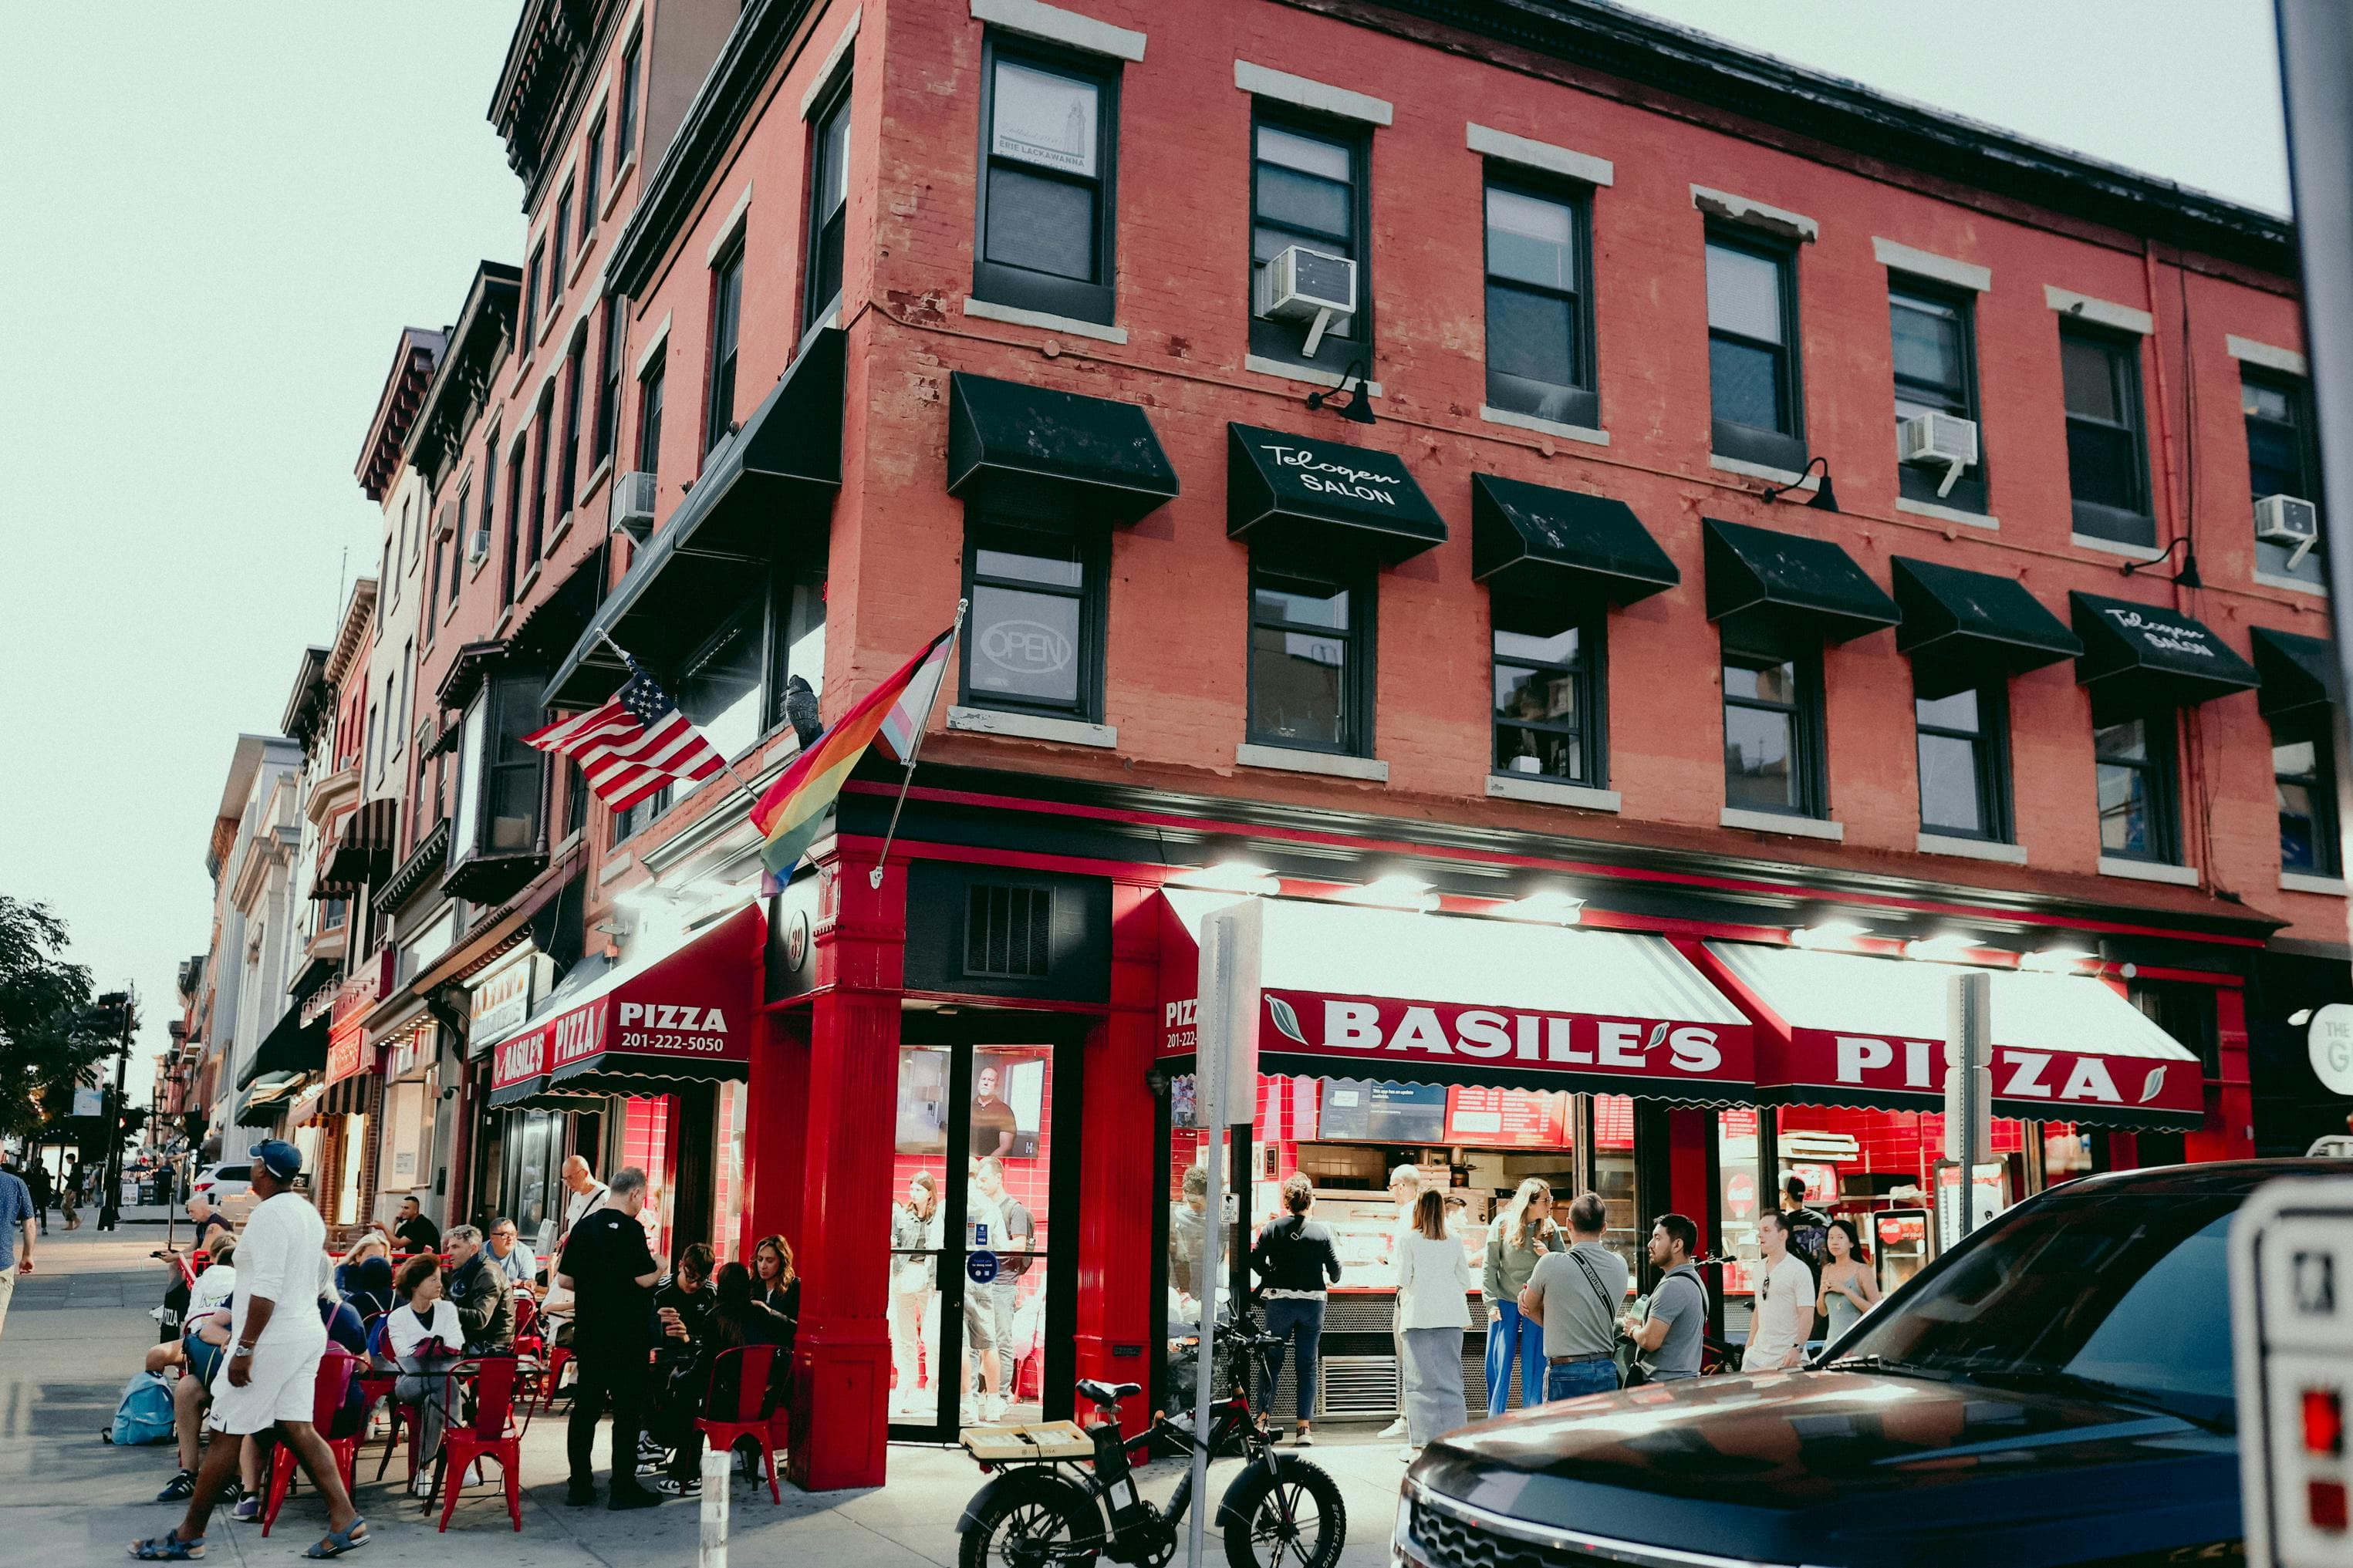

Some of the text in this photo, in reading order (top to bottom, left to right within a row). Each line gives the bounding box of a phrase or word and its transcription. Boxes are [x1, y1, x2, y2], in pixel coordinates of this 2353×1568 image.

[1000, 140, 1019, 152] ERIE
[1021, 145, 1085, 167] LACKAWANNA
[1261, 445, 1401, 484] Telogen
[1300, 474, 1396, 506] SALON
[984, 629, 1063, 668] OPEN
[619, 1002, 729, 1033] PIZZA
[1166, 998, 1198, 1028] PIZZ
[504, 1032, 545, 1081] BASILE'S
[554, 1007, 595, 1064] PIZZA
[621, 1033, 724, 1052] 201-222-5050
[1166, 1030, 1197, 1048] 201-222-
[1322, 1000, 1722, 1072] BASILE'S
[2324, 1021, 2351, 1038] THE
[1835, 1036, 2124, 1103] PIZA
[2328, 1040, 2353, 1073] G
